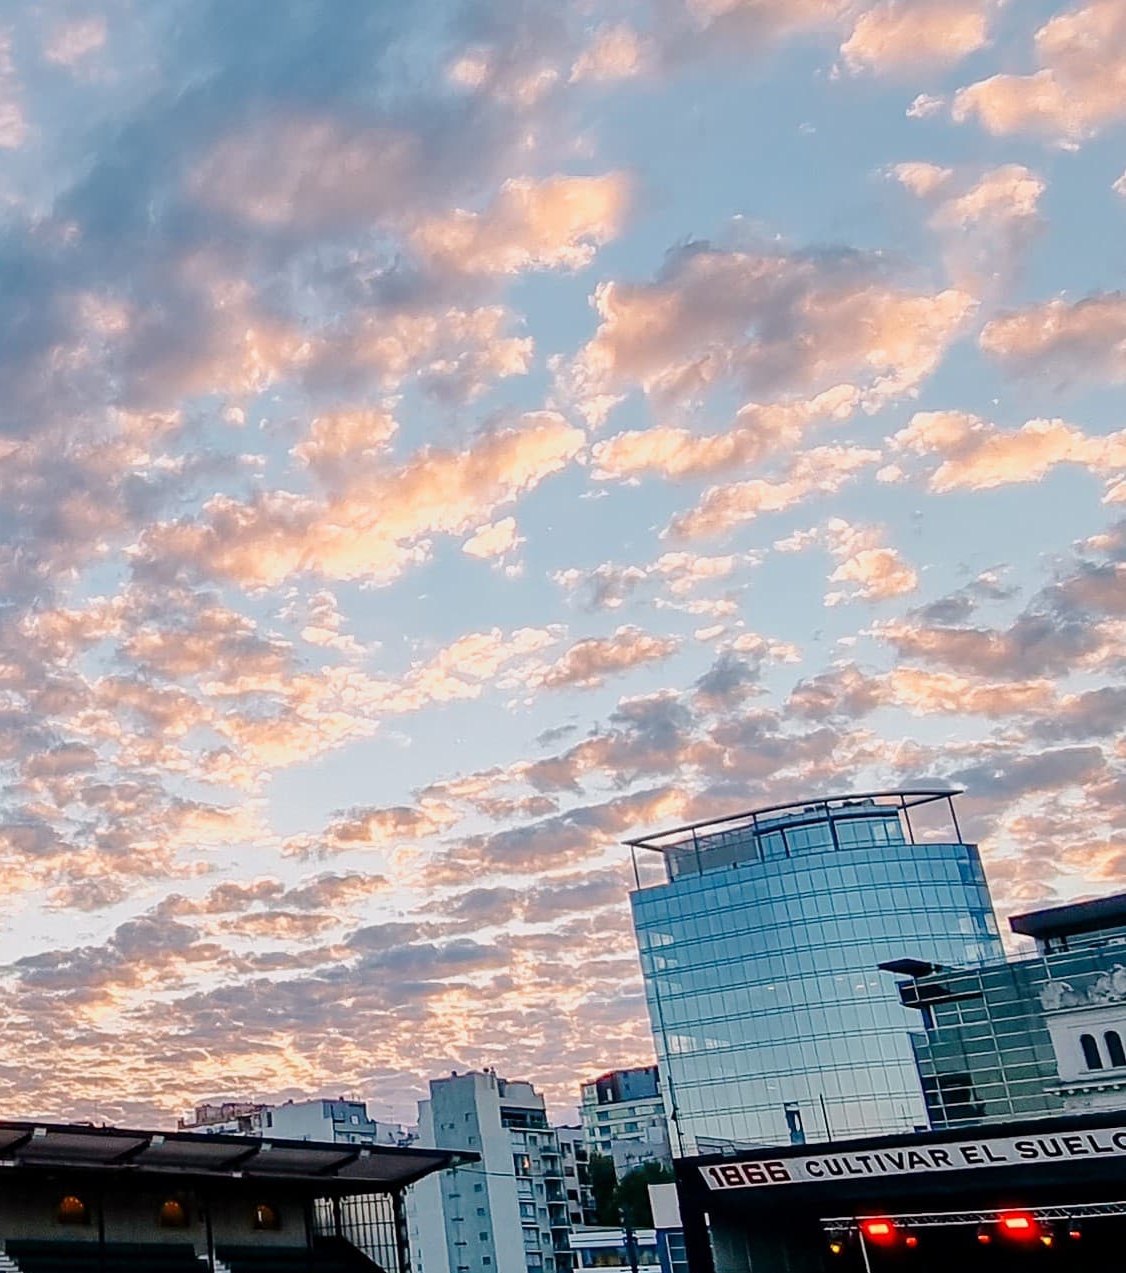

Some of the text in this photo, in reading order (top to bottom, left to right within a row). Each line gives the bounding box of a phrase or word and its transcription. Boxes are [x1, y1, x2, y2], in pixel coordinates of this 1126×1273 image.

[708, 1161, 792, 1188] 1866
[805, 1149, 953, 1177] CULTIVAR
[960, 1144, 1007, 1165] EL
